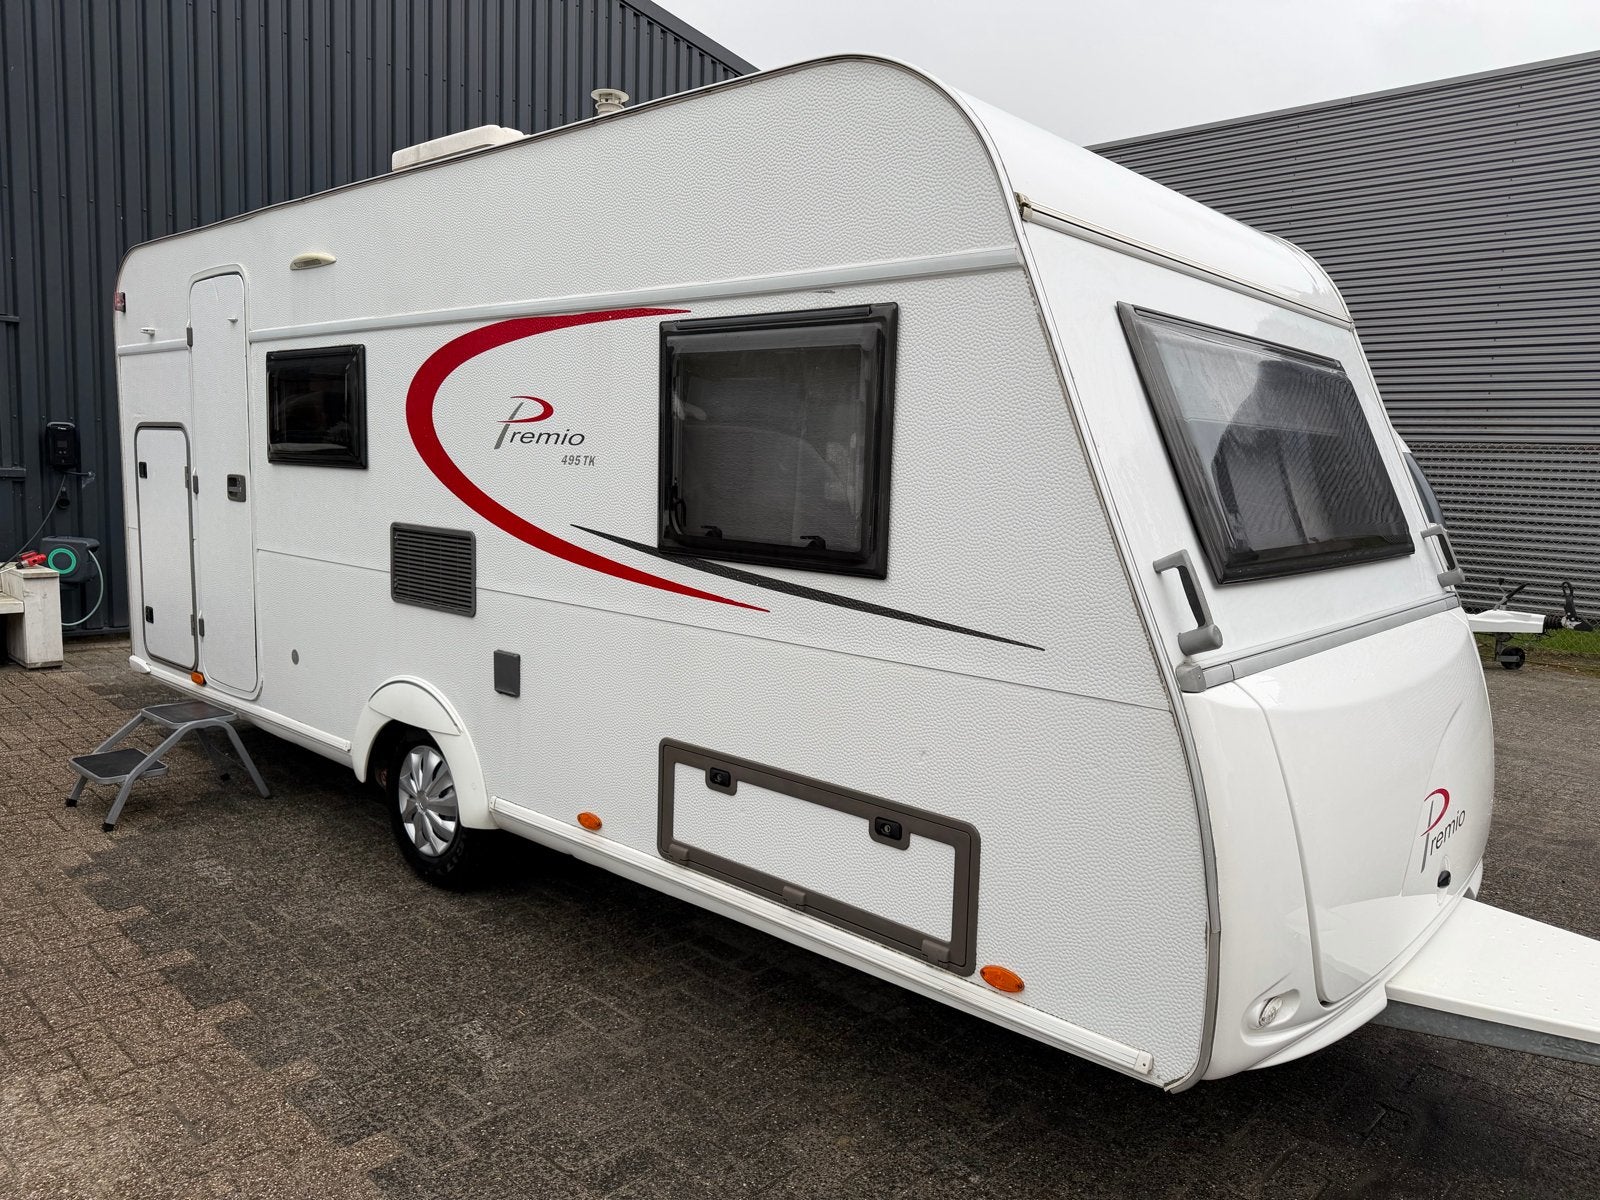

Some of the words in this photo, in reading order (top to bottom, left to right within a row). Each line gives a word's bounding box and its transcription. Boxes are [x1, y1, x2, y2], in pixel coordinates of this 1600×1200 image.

[493, 395, 585, 450] Premio
[561, 455, 581, 466] 495
[583, 455, 596, 467] TK
[1420, 788, 1466, 874] Premio
